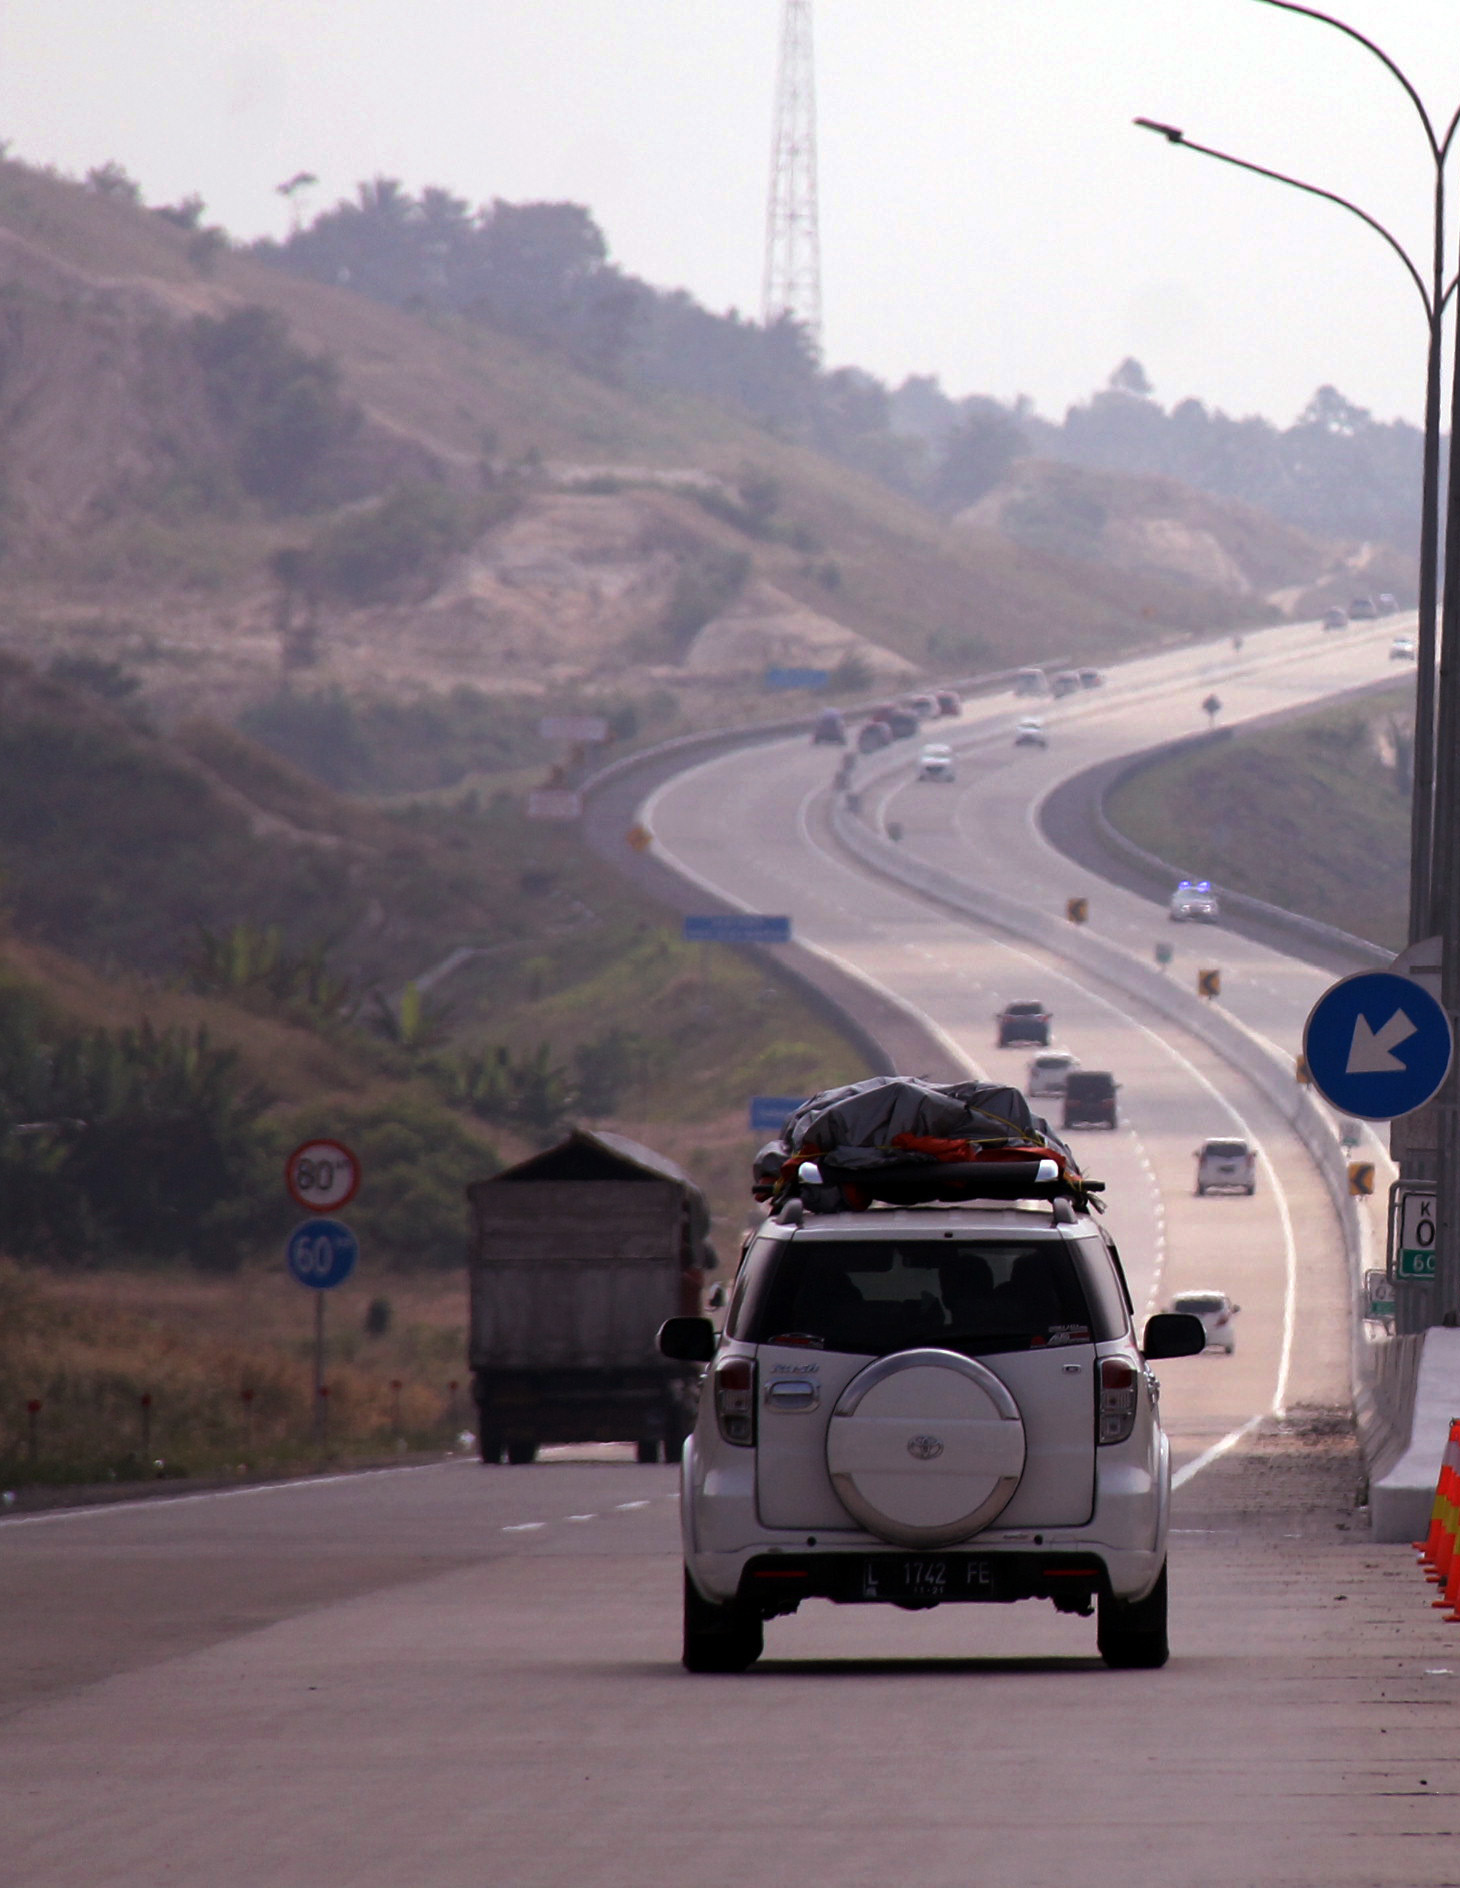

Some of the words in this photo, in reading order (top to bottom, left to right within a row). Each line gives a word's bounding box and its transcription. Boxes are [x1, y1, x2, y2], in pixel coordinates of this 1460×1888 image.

[297, 1157, 333, 1190] 80
[296, 1235, 333, 1276] 60
[868, 1563, 879, 1585] L
[904, 1562, 947, 1584] 1742
[967, 1561, 990, 1584] FE
